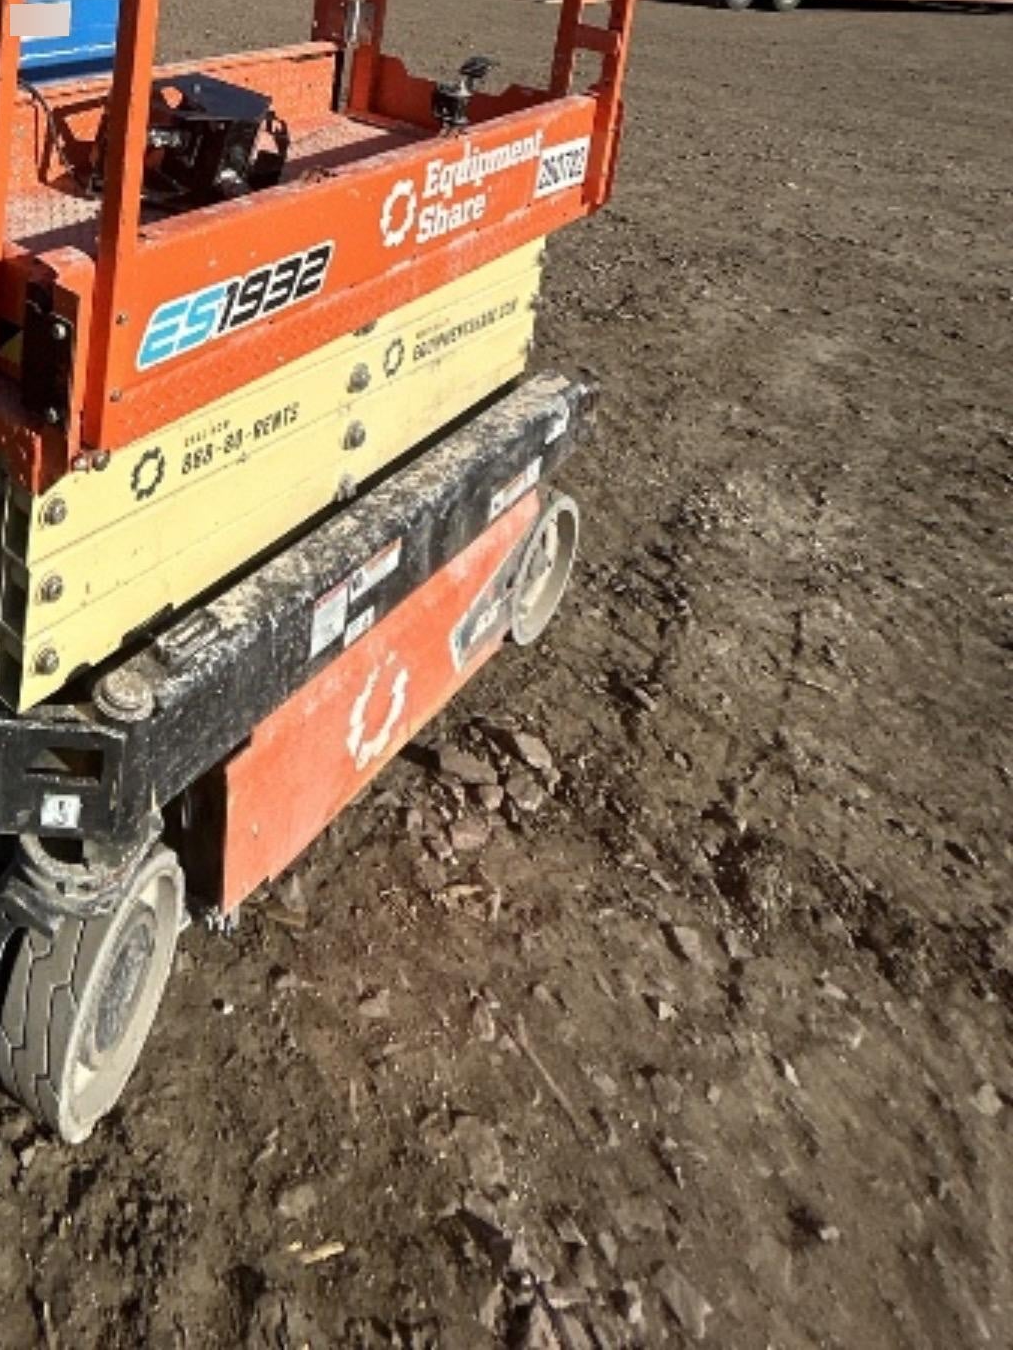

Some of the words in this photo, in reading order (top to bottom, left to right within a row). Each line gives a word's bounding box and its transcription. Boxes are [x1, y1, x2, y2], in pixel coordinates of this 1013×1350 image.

[421, 128, 544, 199] Equipment
[415, 193, 487, 245] Share
[137, 241, 335, 371] ES1932
